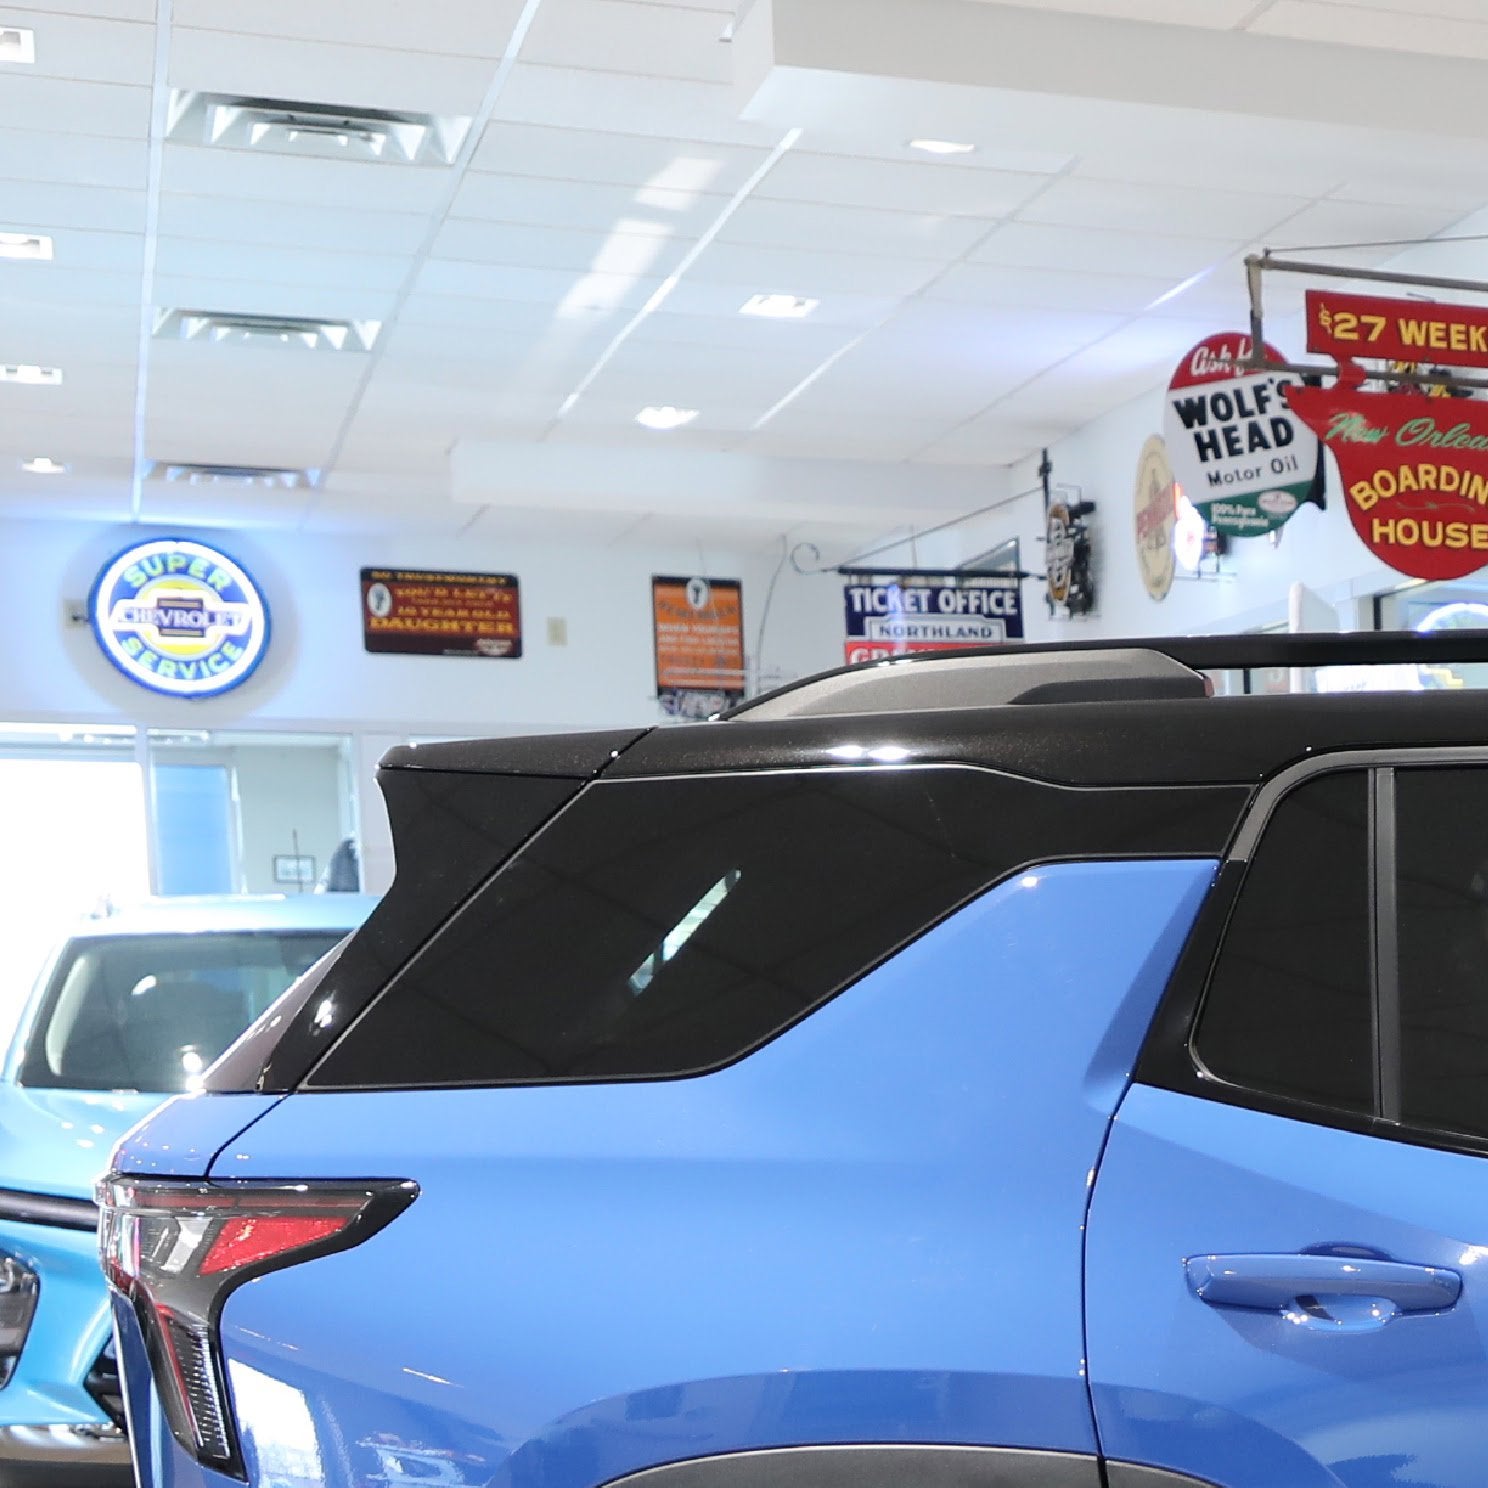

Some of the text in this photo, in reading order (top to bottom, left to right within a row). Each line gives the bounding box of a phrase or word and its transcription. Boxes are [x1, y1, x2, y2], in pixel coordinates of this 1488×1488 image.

[1318, 303, 1387, 342] $27
[1193, 417, 1294, 463] HEAD
[1324, 412, 1390, 443] New
[1207, 455, 1299, 487] Motor Oil
[123, 554, 233, 591] SUPER
[850, 587, 1018, 615] TICKET OFFICE
[119, 607, 245, 630] CHEVROLET
[370, 616, 514, 635] DAUGHTER
[878, 625, 993, 639] NORTHLAND
[121, 636, 245, 680] SERVICE
